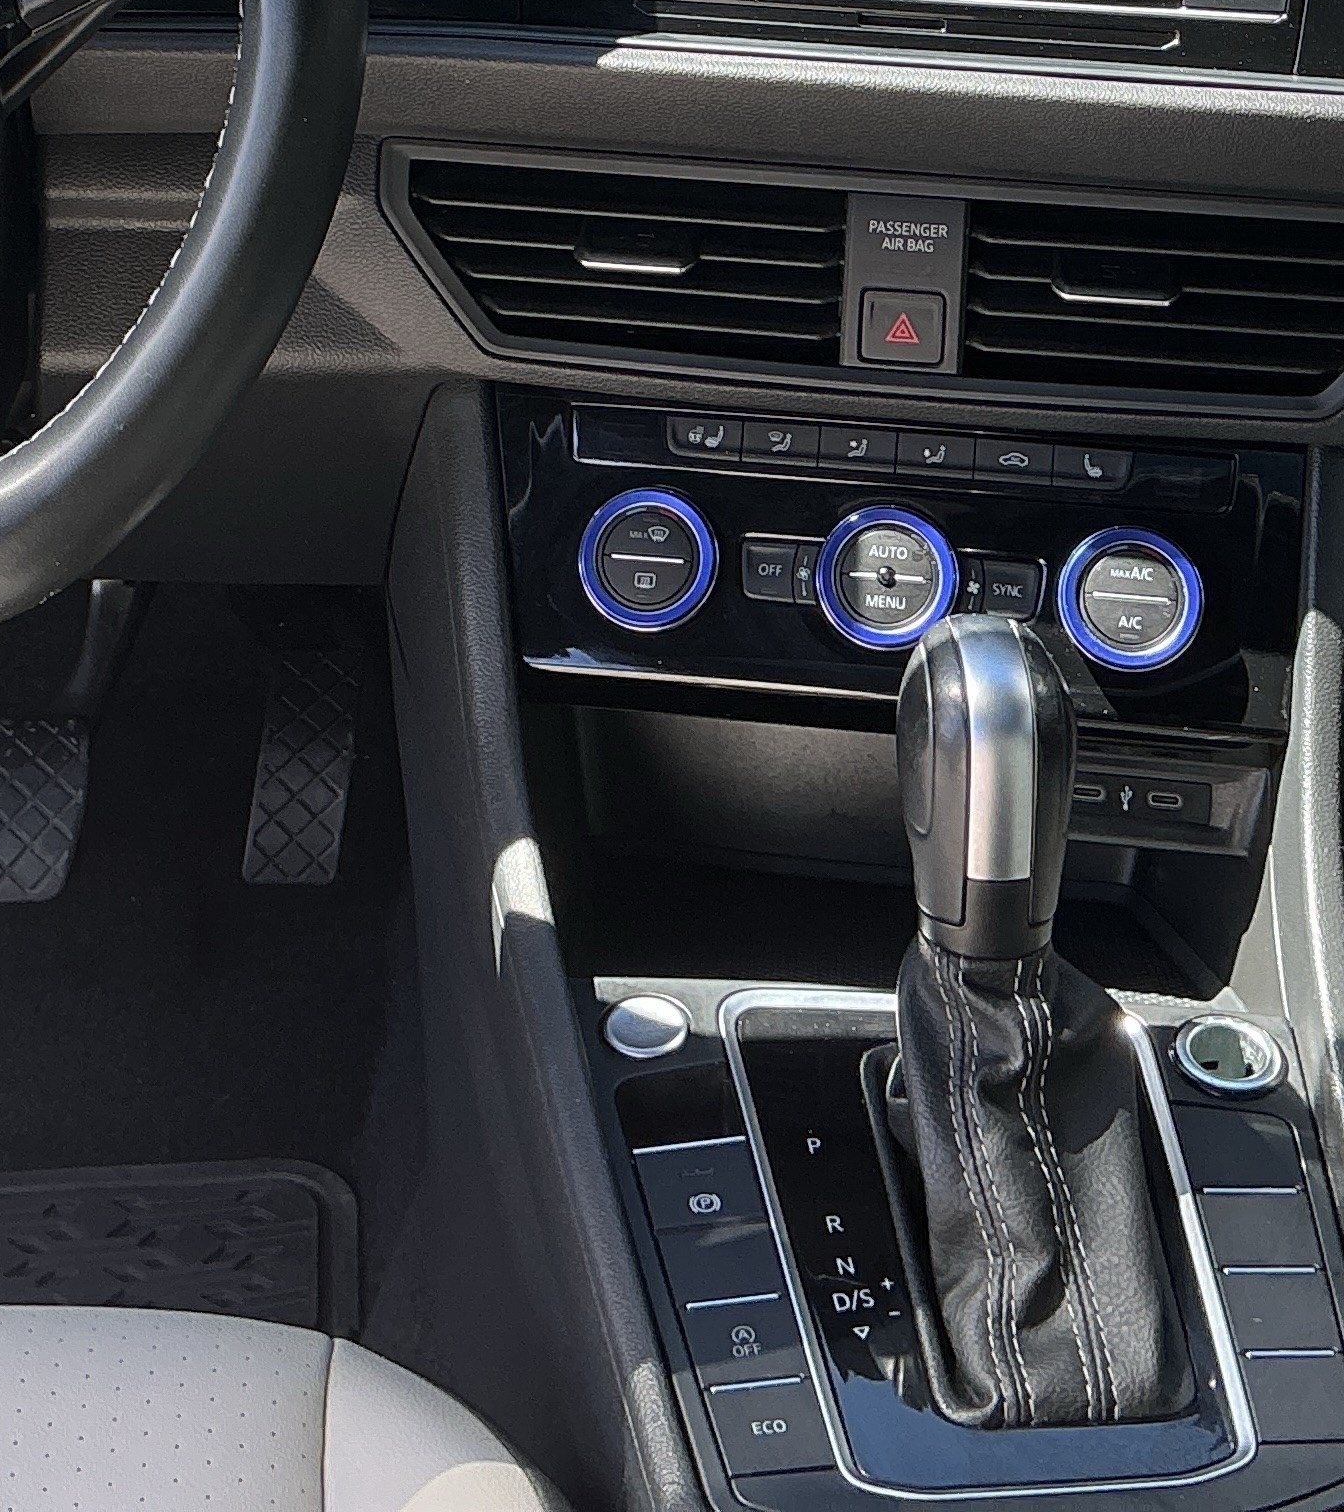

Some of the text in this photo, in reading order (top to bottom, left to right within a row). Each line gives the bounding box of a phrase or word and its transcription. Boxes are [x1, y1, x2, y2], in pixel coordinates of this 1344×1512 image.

[868, 219, 949, 238] PASSENGER
[881, 236, 935, 253] AIR BAG
[868, 544, 908, 560] AUTO
[757, 563, 783, 577] OFF
[992, 583, 1024, 598] SYNC
[865, 594, 907, 610] MENU
[1118, 615, 1143, 630] A/C
[806, 1137, 821, 1155] P
[825, 1215, 844, 1233] R
[835, 1256, 856, 1275] N
[831, 1288, 875, 1313] D/S
[732, 1342, 762, 1359] OFF
[751, 1418, 788, 1437] ECO
